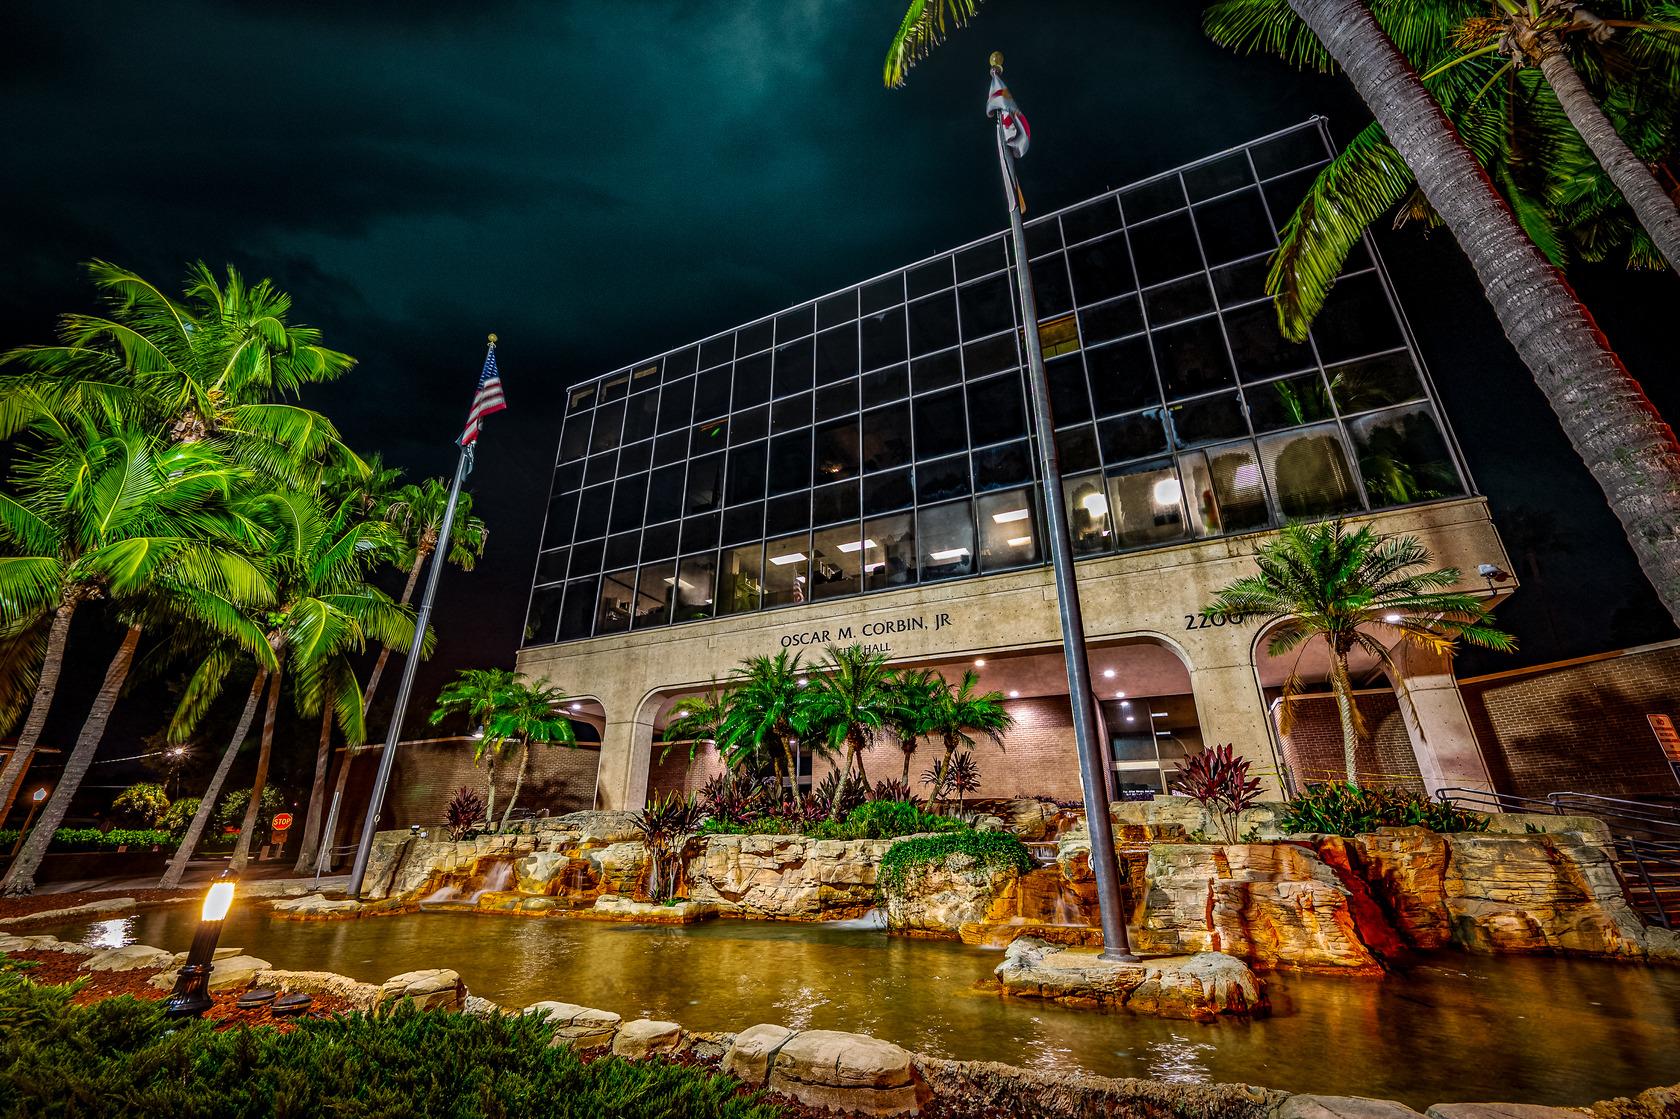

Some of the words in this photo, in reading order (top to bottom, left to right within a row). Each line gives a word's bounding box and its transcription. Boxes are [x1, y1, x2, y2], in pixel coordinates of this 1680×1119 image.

[1184, 612, 1244, 631] 2200
[780, 630, 831, 648] OSCAR
[837, 627, 856, 641] M.
[862, 616, 928, 637] CORBIN,
[935, 613, 952, 631] JR
[863, 642, 892, 656] HALL
[273, 818, 291, 826] STOP
